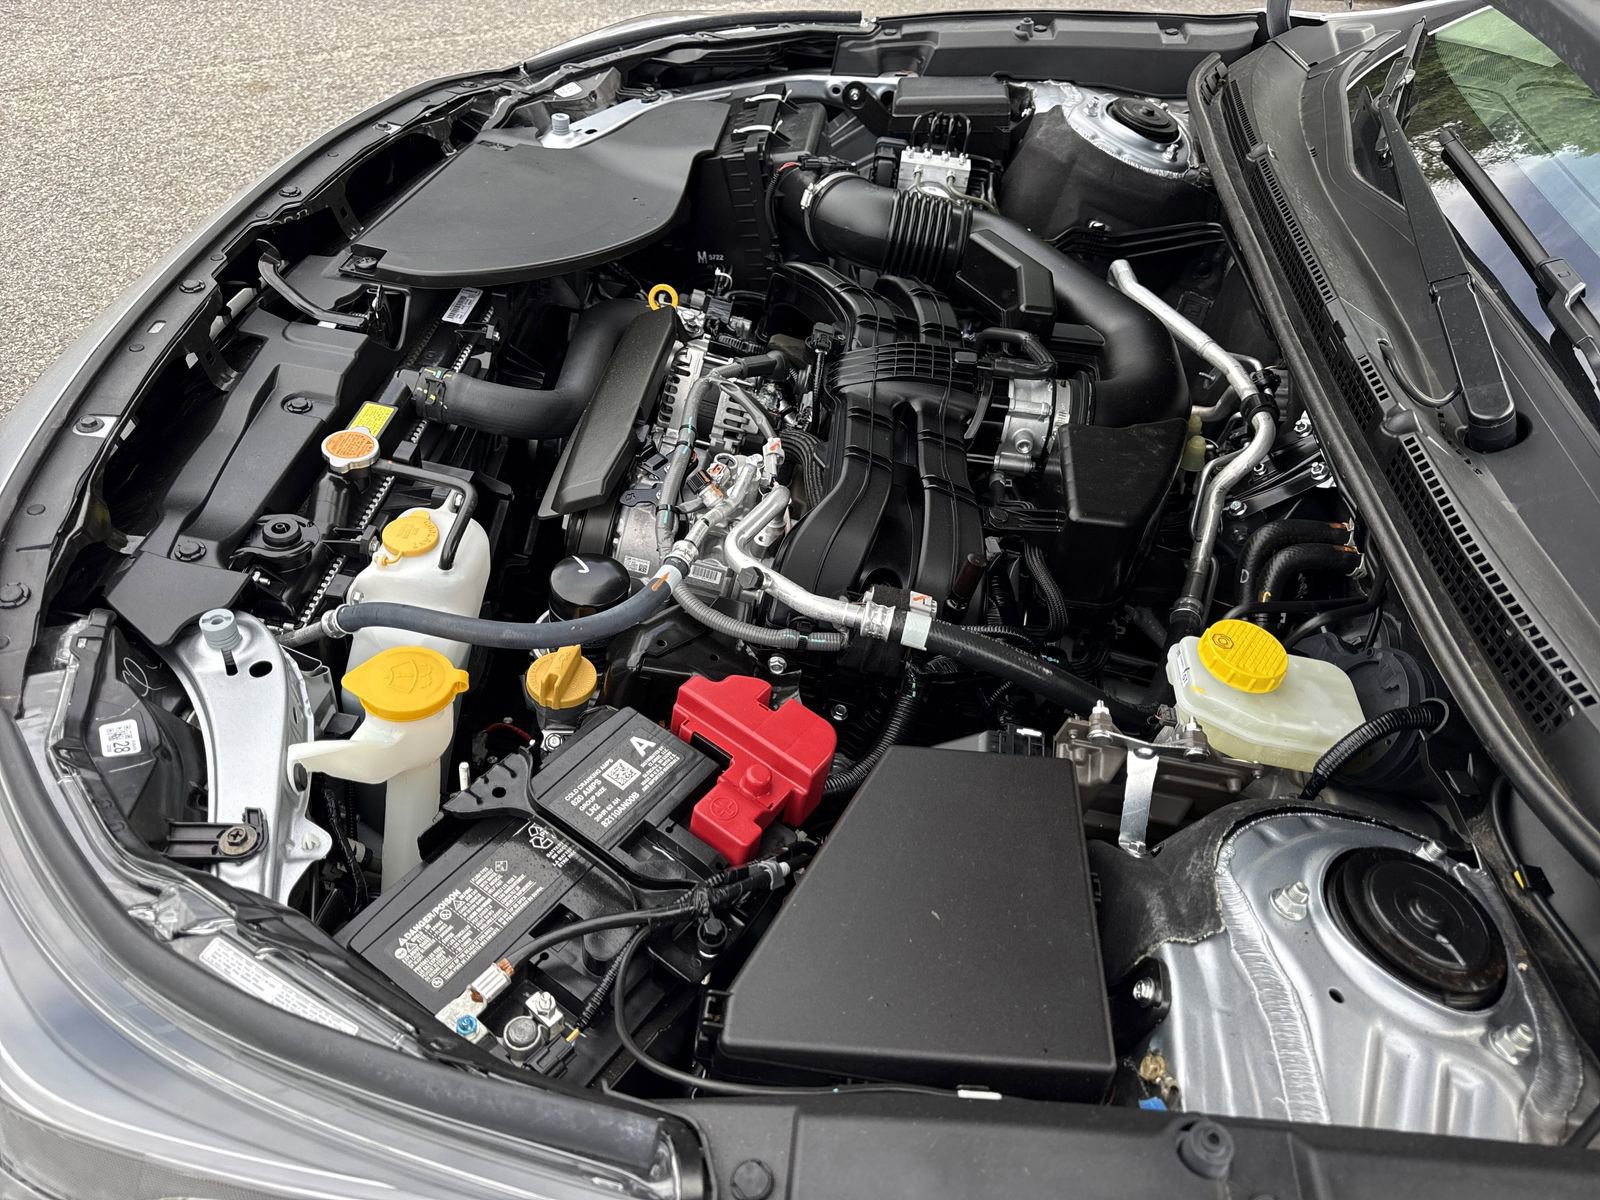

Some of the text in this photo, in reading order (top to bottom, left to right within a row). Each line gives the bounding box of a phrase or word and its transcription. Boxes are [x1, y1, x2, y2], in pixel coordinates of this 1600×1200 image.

[113, 741, 131, 753] 28
[629, 735, 657, 757] A
[564, 758, 614, 801] COLD CRANKING AMPS
[570, 778, 602, 806] 620 AMPS
[579, 786, 607, 811] GROUP SIZE
[585, 803, 601, 816] LN2
[600, 791, 640, 828] 82110AN00B
[403, 888, 462, 940] DANGER/POISON
